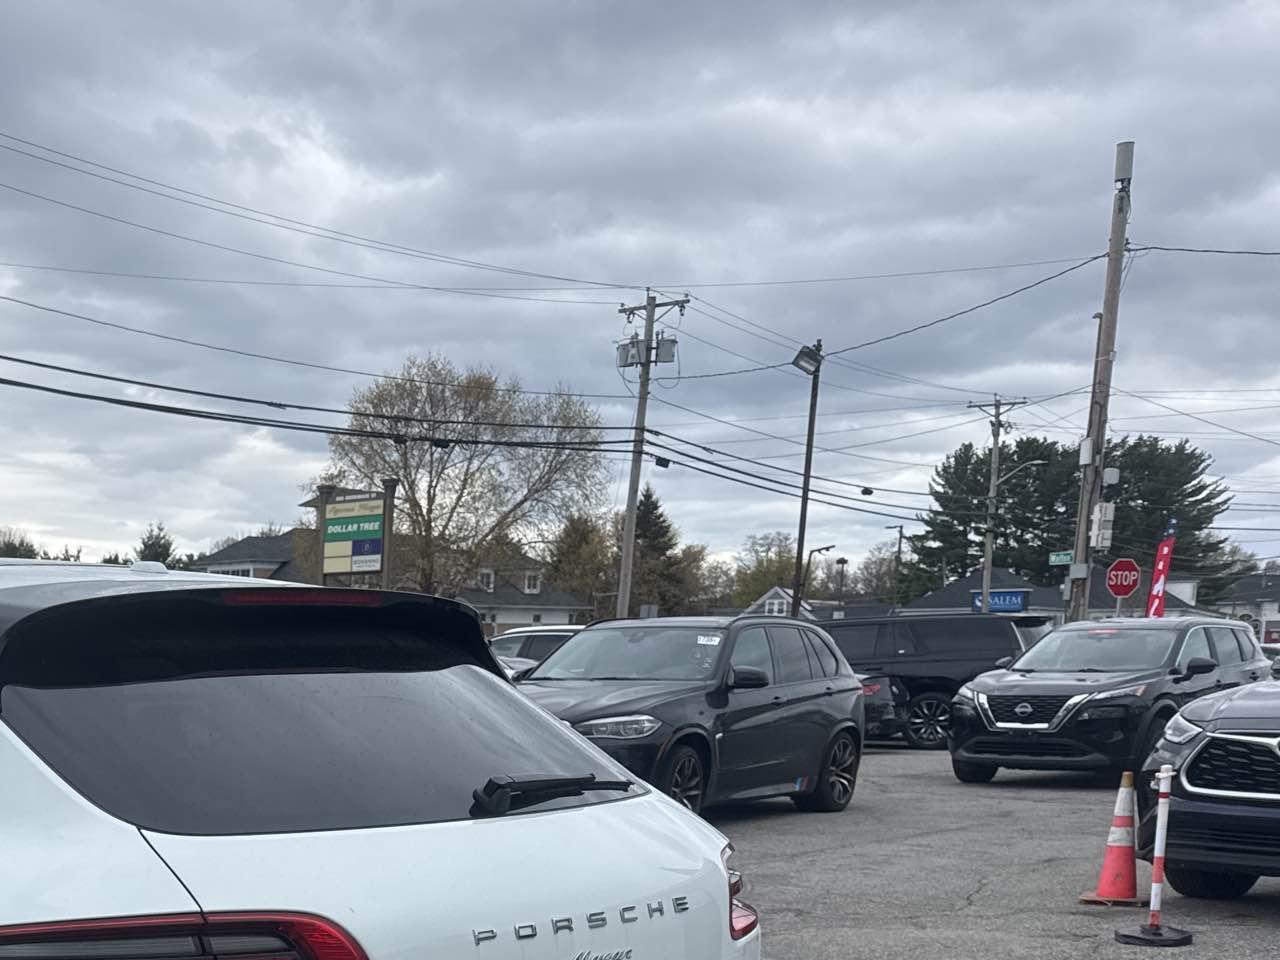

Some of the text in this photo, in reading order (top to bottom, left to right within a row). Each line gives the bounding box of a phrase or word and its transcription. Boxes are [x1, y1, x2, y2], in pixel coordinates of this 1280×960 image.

[327, 521, 380, 534] DOLLAR TREE
[1109, 571, 1138, 585] STOP
[472, 896, 689, 947] PORSCHE
